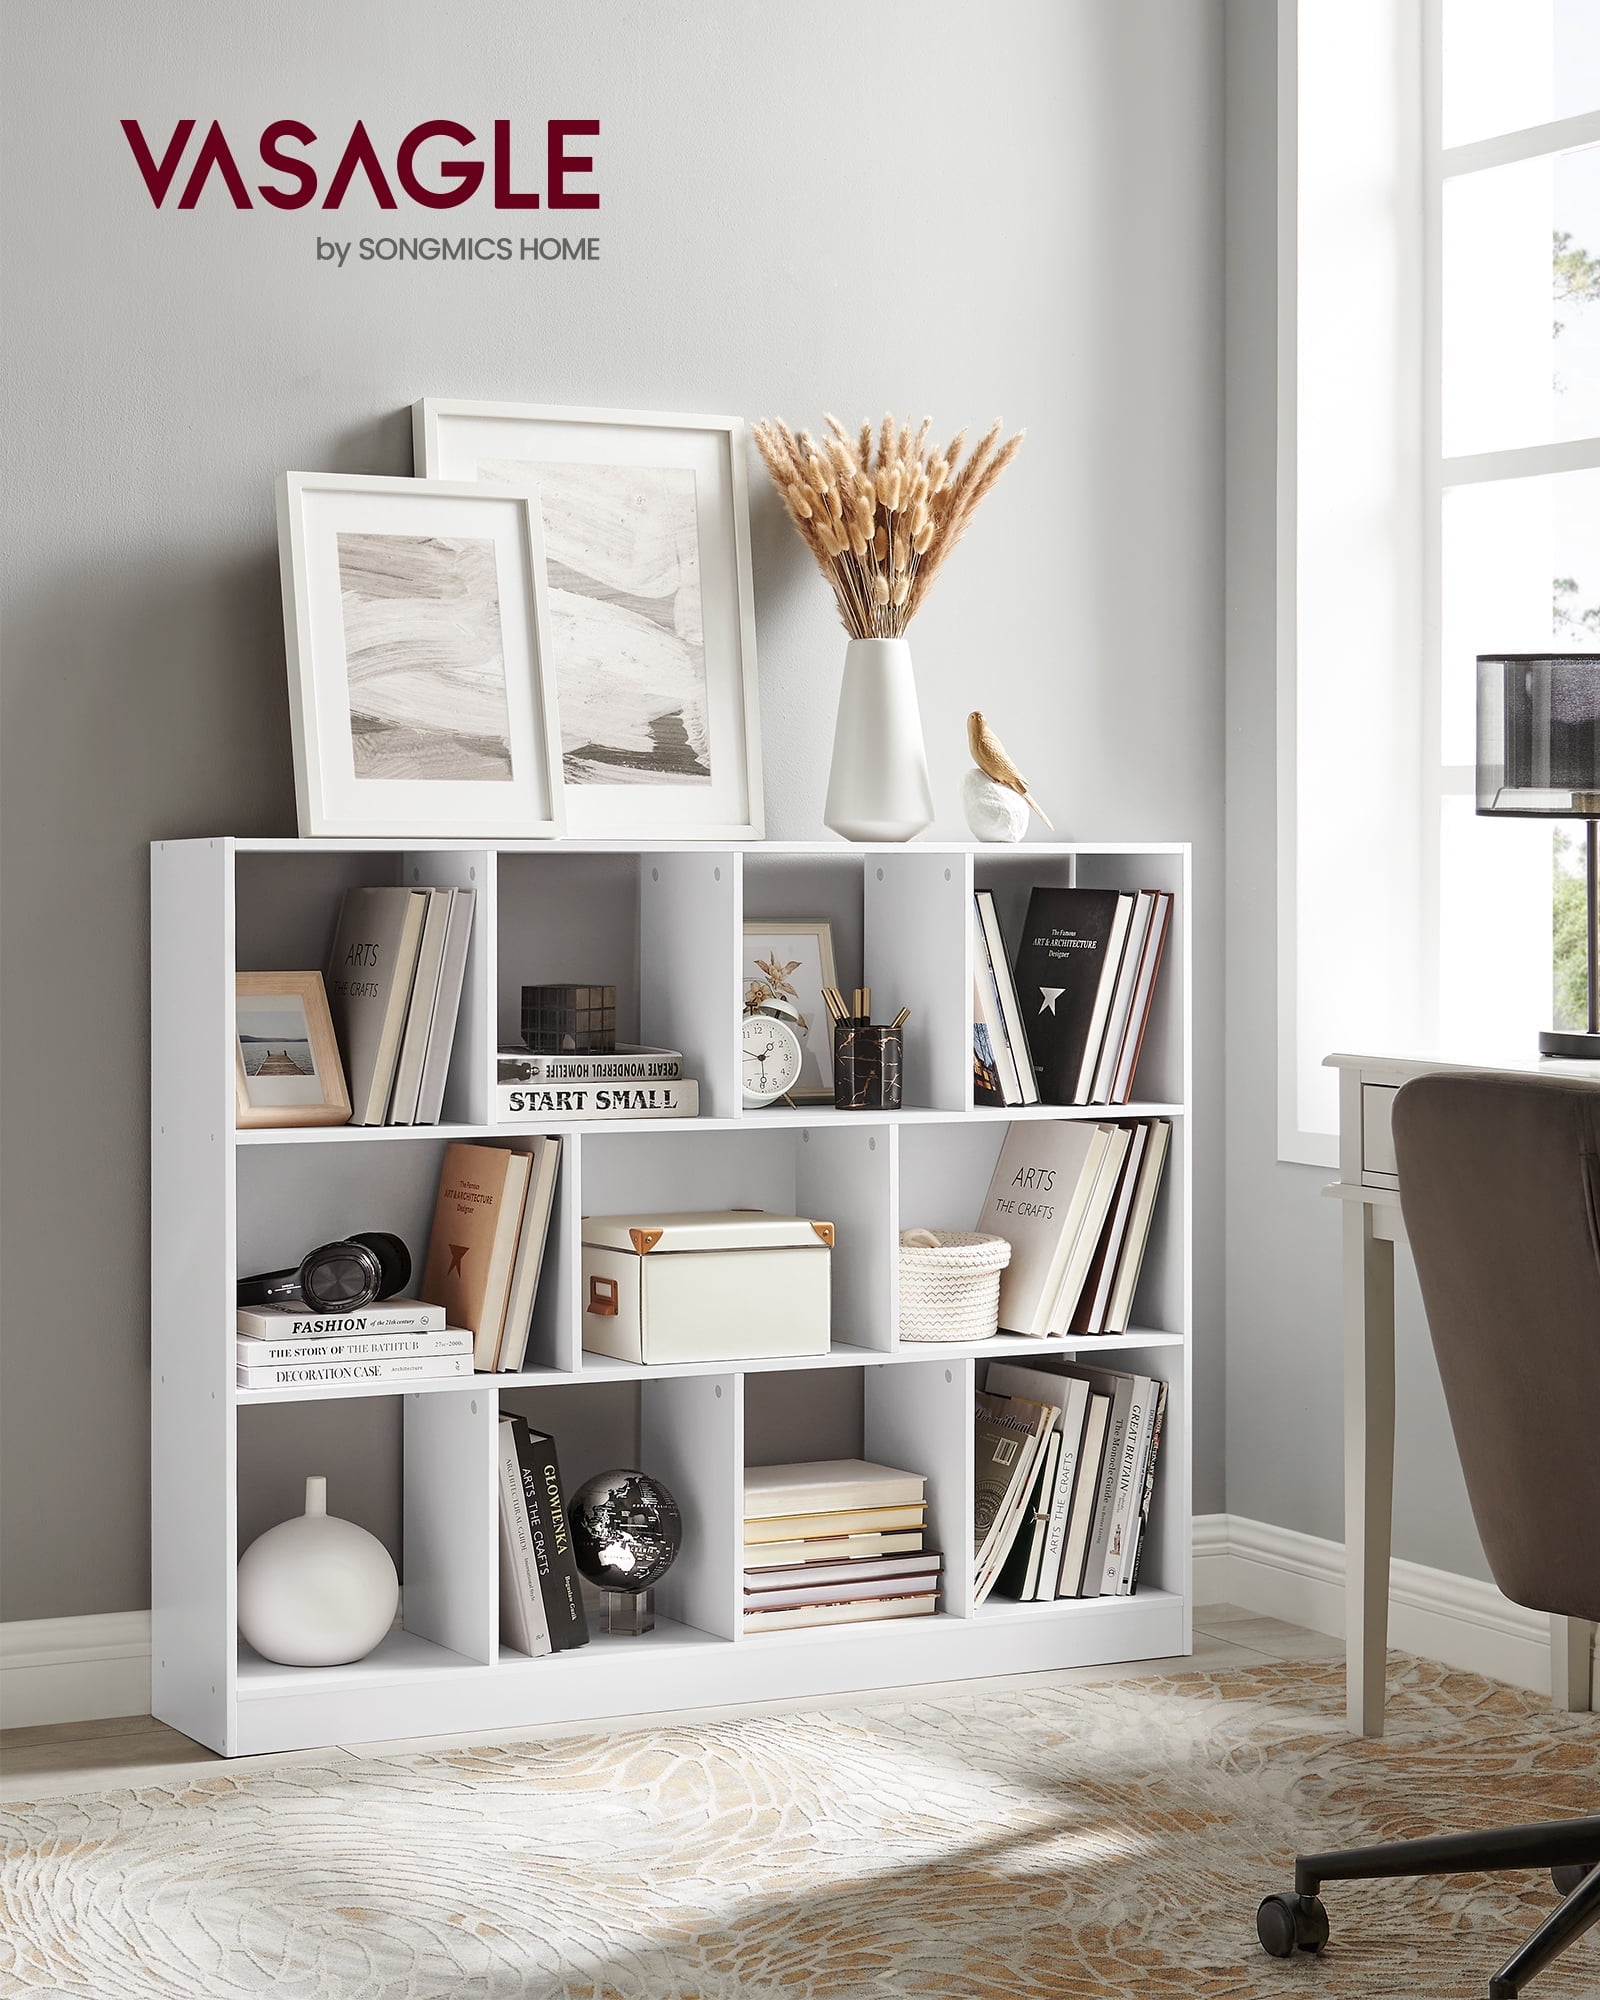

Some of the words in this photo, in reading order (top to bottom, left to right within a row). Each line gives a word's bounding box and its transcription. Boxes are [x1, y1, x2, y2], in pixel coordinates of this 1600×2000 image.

[1032, 938, 1046, 946] ART
[1050, 939, 1098, 949] ARCHITECTURE
[345, 943, 380, 967] ARTS
[350, 982, 379, 998] CRAFTS
[754, 1026, 763, 1035] 12
[778, 1040, 784, 1048] 2
[783, 1053, 789, 1062] 3
[546, 1064, 589, 1078] HOMELIFE
[592, 1063, 646, 1077] WONDERFUL
[647, 1062, 679, 1076] CREATE
[780, 1068, 786, 1076] 4
[772, 1078, 778, 1086] 5
[509, 1090, 588, 1112] START
[596, 1089, 678, 1110] SMALL
[1011, 1166, 1057, 1192] ARTS
[996, 1198, 1016, 1214] THE
[1017, 1202, 1055, 1220] CRAFTS
[291, 1318, 368, 1335] FASHION
[396, 1319, 415, 1327] century
[269, 1348, 292, 1358] THE
[294, 1346, 328, 1357] STORY
[330, 1345, 345, 1355] OF
[347, 1344, 369, 1353] THE
[371, 1341, 419, 1352] BATHTUB
[276, 1367, 352, 1383] DECORATION
[353, 1365, 382, 1379] CASE
[1114, 1419, 1124, 1436] The
[1128, 1404, 1141, 1443] GREAT
[1108, 1437, 1121, 1475] Monocle
[1059, 1452, 1073, 1494] CRAFTS
[1120, 1444, 1135, 1492] BRITAIN
[505, 1458, 523, 1525] ARCHITECTURAL
[521, 1468, 536, 1498] ARTS
[1103, 1477, 1114, 1504] Guide
[528, 1501, 541, 1527] THE
[1054, 1498, 1065, 1521] THE
[1050, 1526, 1061, 1555] ARTS
[533, 1531, 550, 1576] CRAFTS
